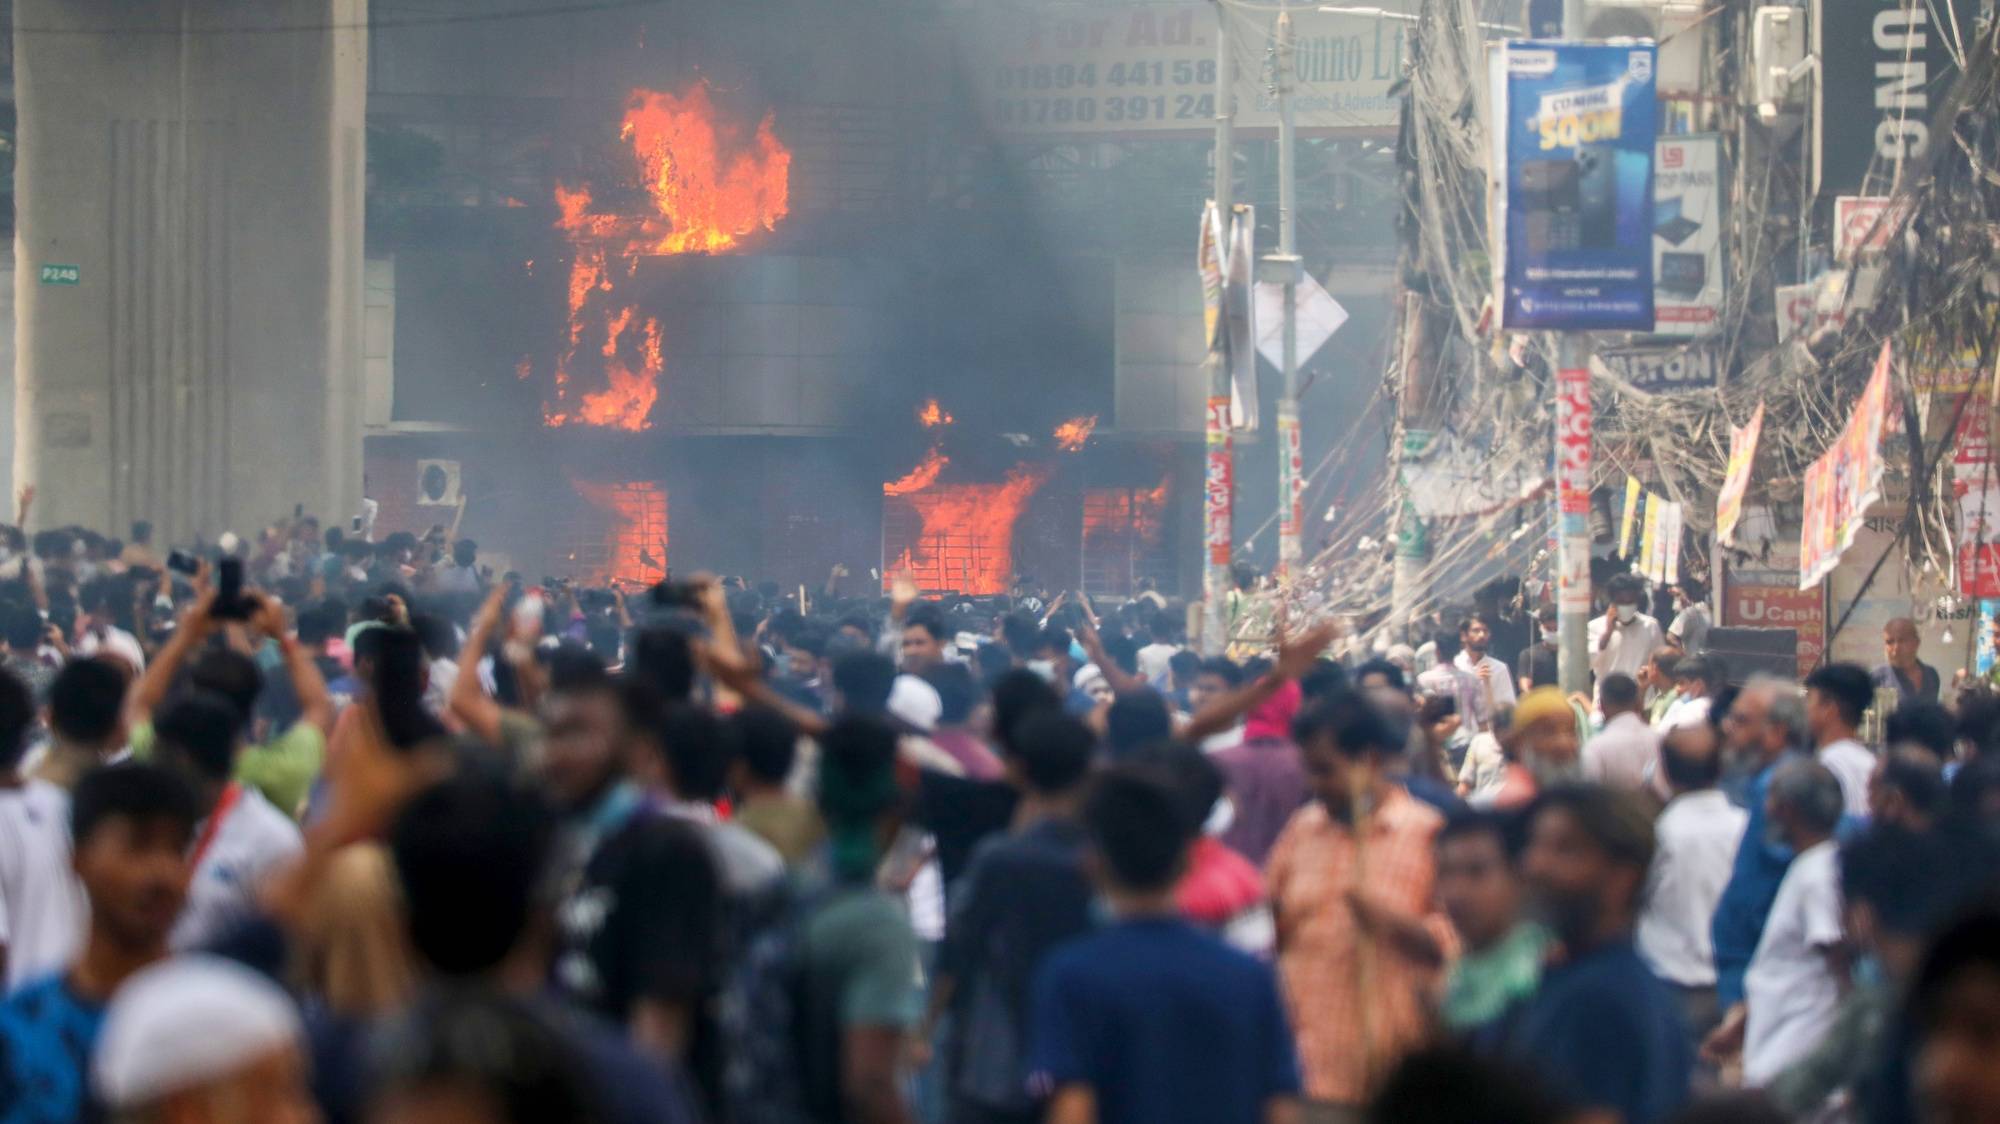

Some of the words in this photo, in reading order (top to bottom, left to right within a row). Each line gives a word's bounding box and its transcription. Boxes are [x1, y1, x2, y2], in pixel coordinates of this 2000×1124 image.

[1126, 9, 1206, 47] Ad.
[1107, 60, 1163, 87] 441
[1172, 58, 1240, 86] 58
[1873, 9, 1929, 159] UNG
[1105, 94, 1164, 121] 391
[1175, 93, 1238, 120] 24
[1539, 112, 1621, 151] SOON
[1604, 354, 1711, 382] ALTON
